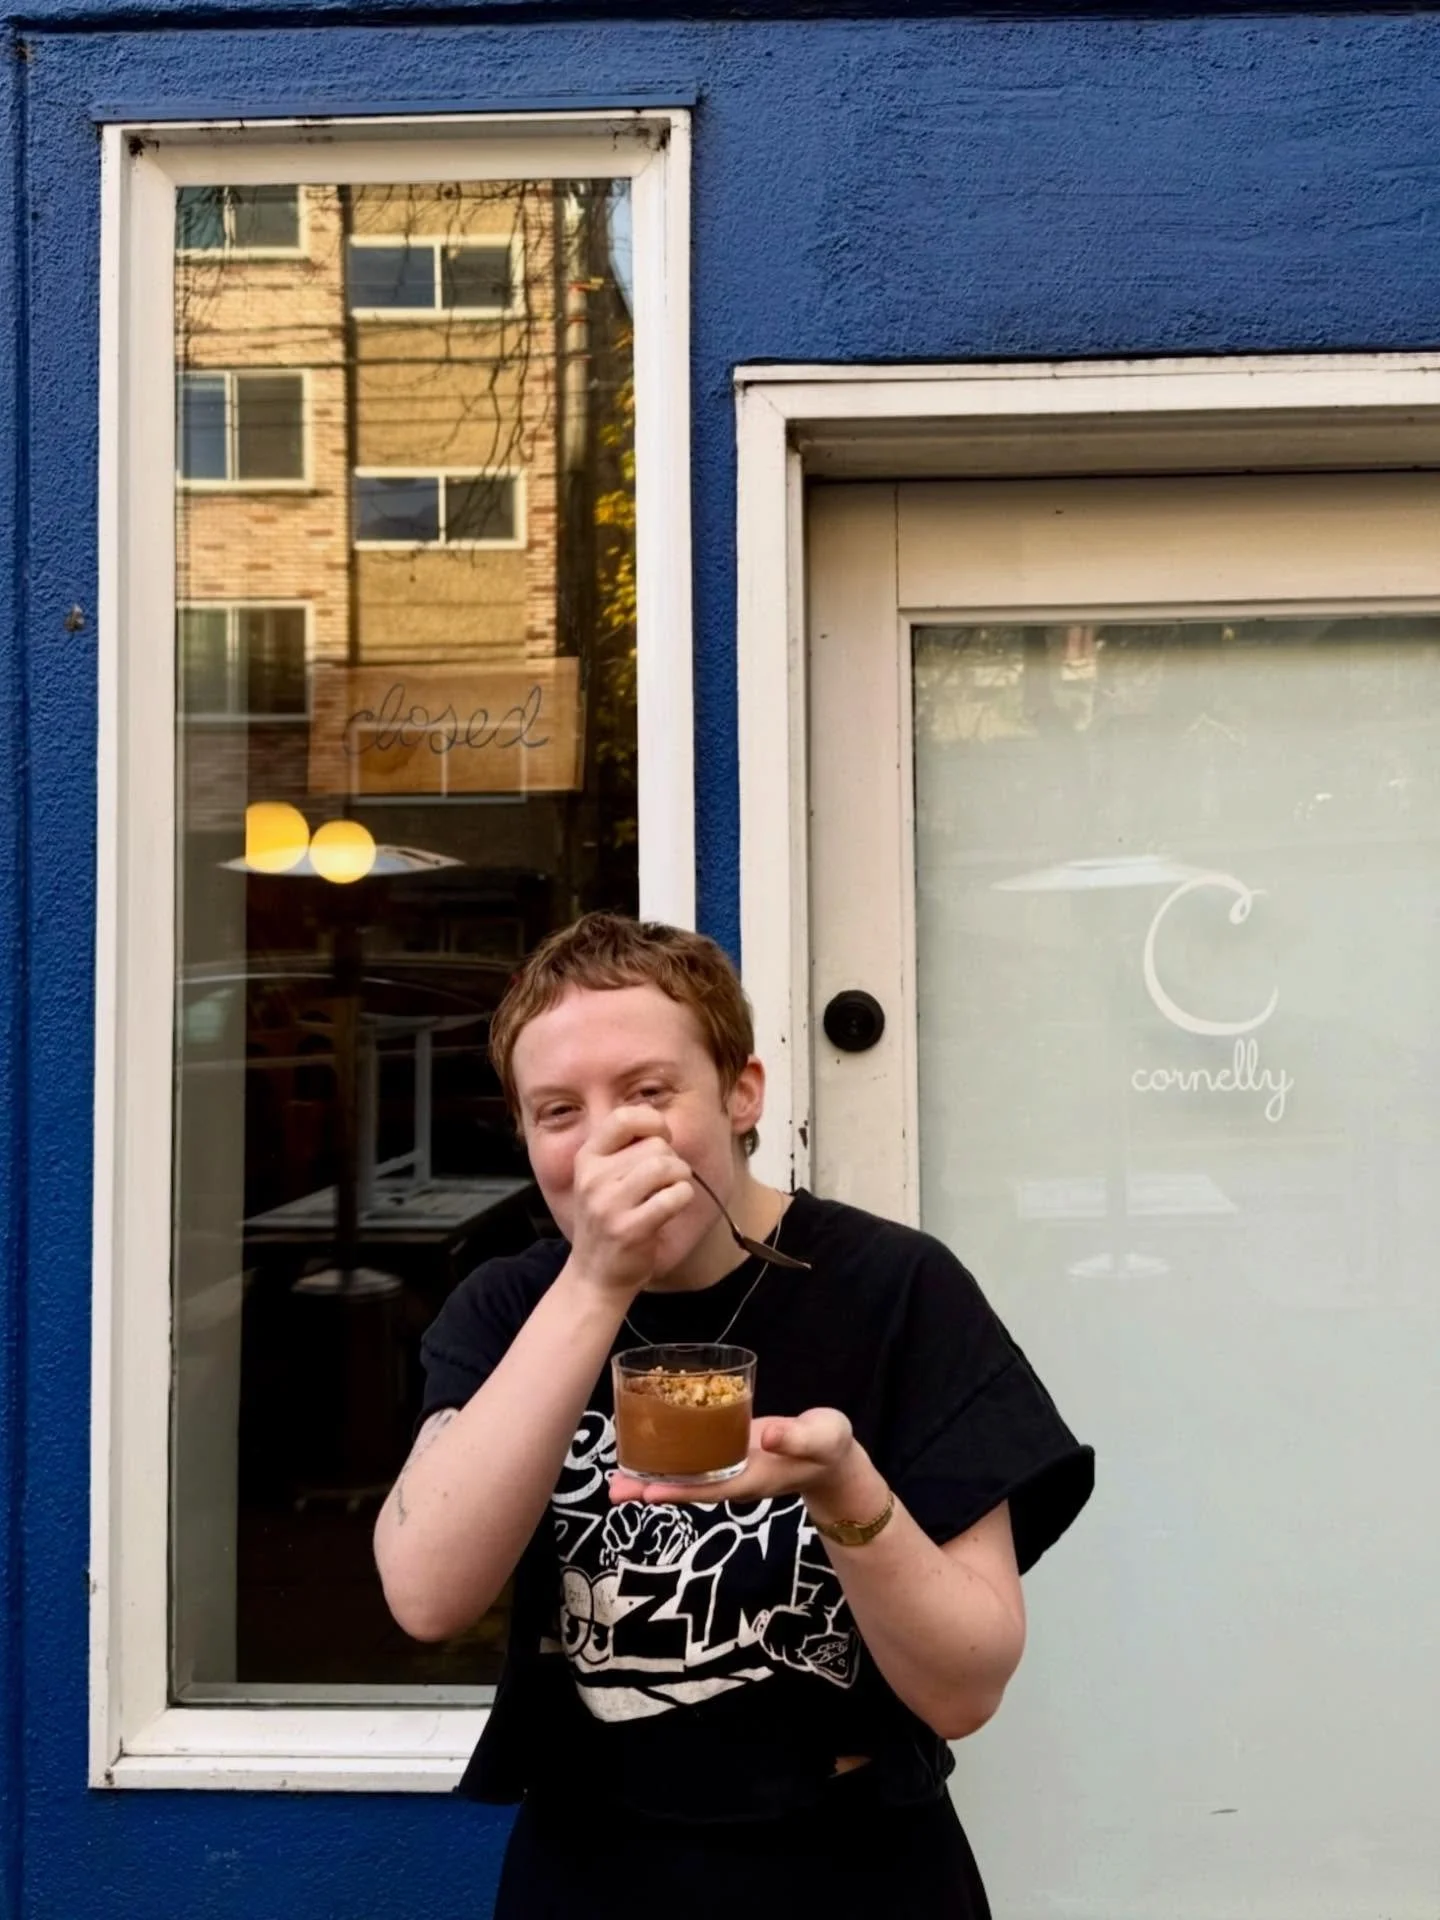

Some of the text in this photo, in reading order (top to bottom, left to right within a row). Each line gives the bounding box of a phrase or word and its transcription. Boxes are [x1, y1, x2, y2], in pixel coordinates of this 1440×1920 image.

[342, 683, 549, 756] closed
[1143, 873, 1280, 1036] C
[1131, 1037, 1295, 1122] cornelly
